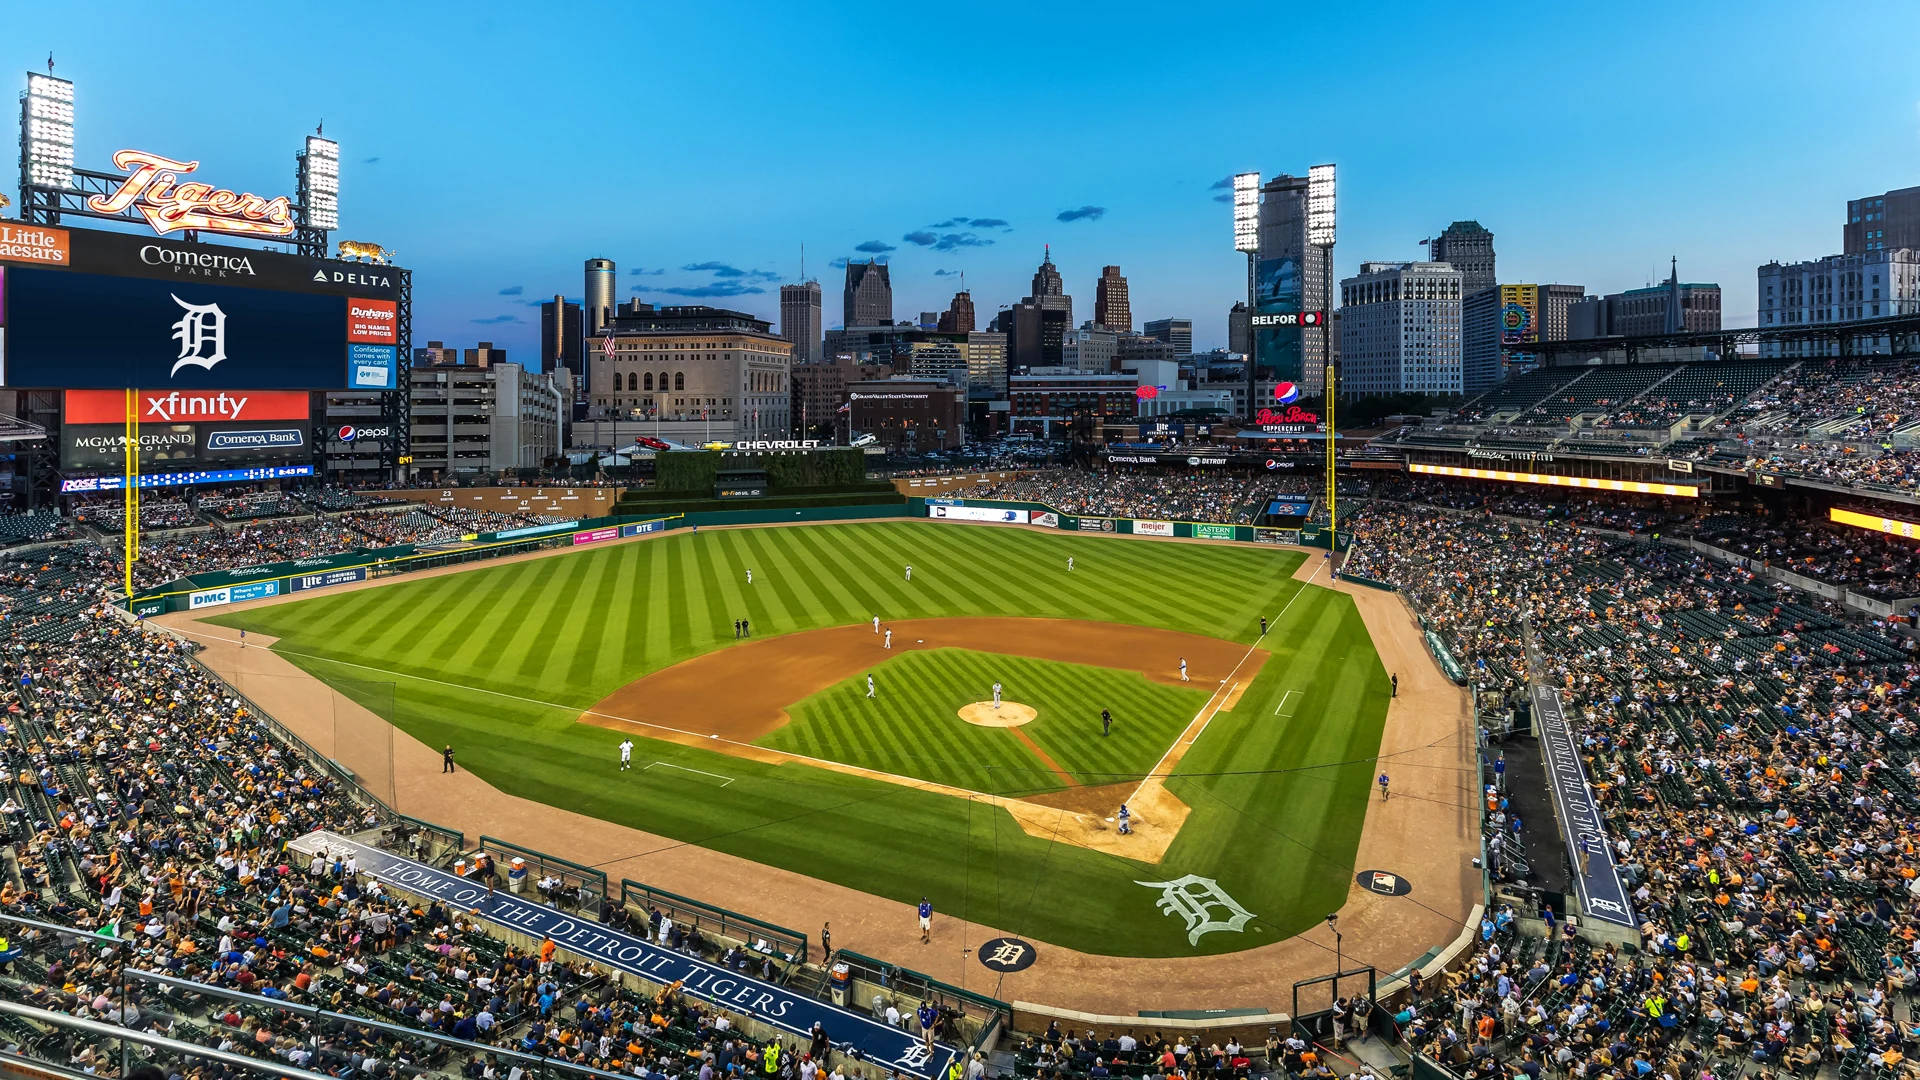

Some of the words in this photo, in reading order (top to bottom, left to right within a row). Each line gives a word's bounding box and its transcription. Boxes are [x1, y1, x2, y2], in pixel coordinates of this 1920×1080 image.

[88, 149, 294, 235] Tigers
[1, 227, 56, 248] Little
[0, 243, 63, 260] aesars
[174, 265, 226, 278] PARK
[333, 272, 390, 287] DELTA
[350, 307, 394, 320] Dunham's
[1252, 315, 1296, 324] BELFOR
[147, 392, 248, 420] xfinity
[357, 426, 389, 439] pepsi
[1156, 423, 1168, 431] Lite
[75, 437, 116, 447] MGM
[140, 434, 192, 445] GRAND
[270, 433, 296, 442] Bank
[737, 440, 819, 450] CHEVROLET
[636, 524, 652, 532] DTE
[1141, 522, 1165, 531] meijer
[302, 576, 322, 588] Lite
[194, 592, 226, 605] DMC
[1544, 709, 1563, 733] TIGERS
[1550, 735, 1576, 773] DETROIT
[1562, 775, 1583, 794] THE
[1568, 798, 1589, 812] OF
[381, 862, 455, 894] HOME
[492, 901, 546, 926] THE
[545, 920, 675, 972] DETROIT
[682, 964, 794, 1016] TIGERS
